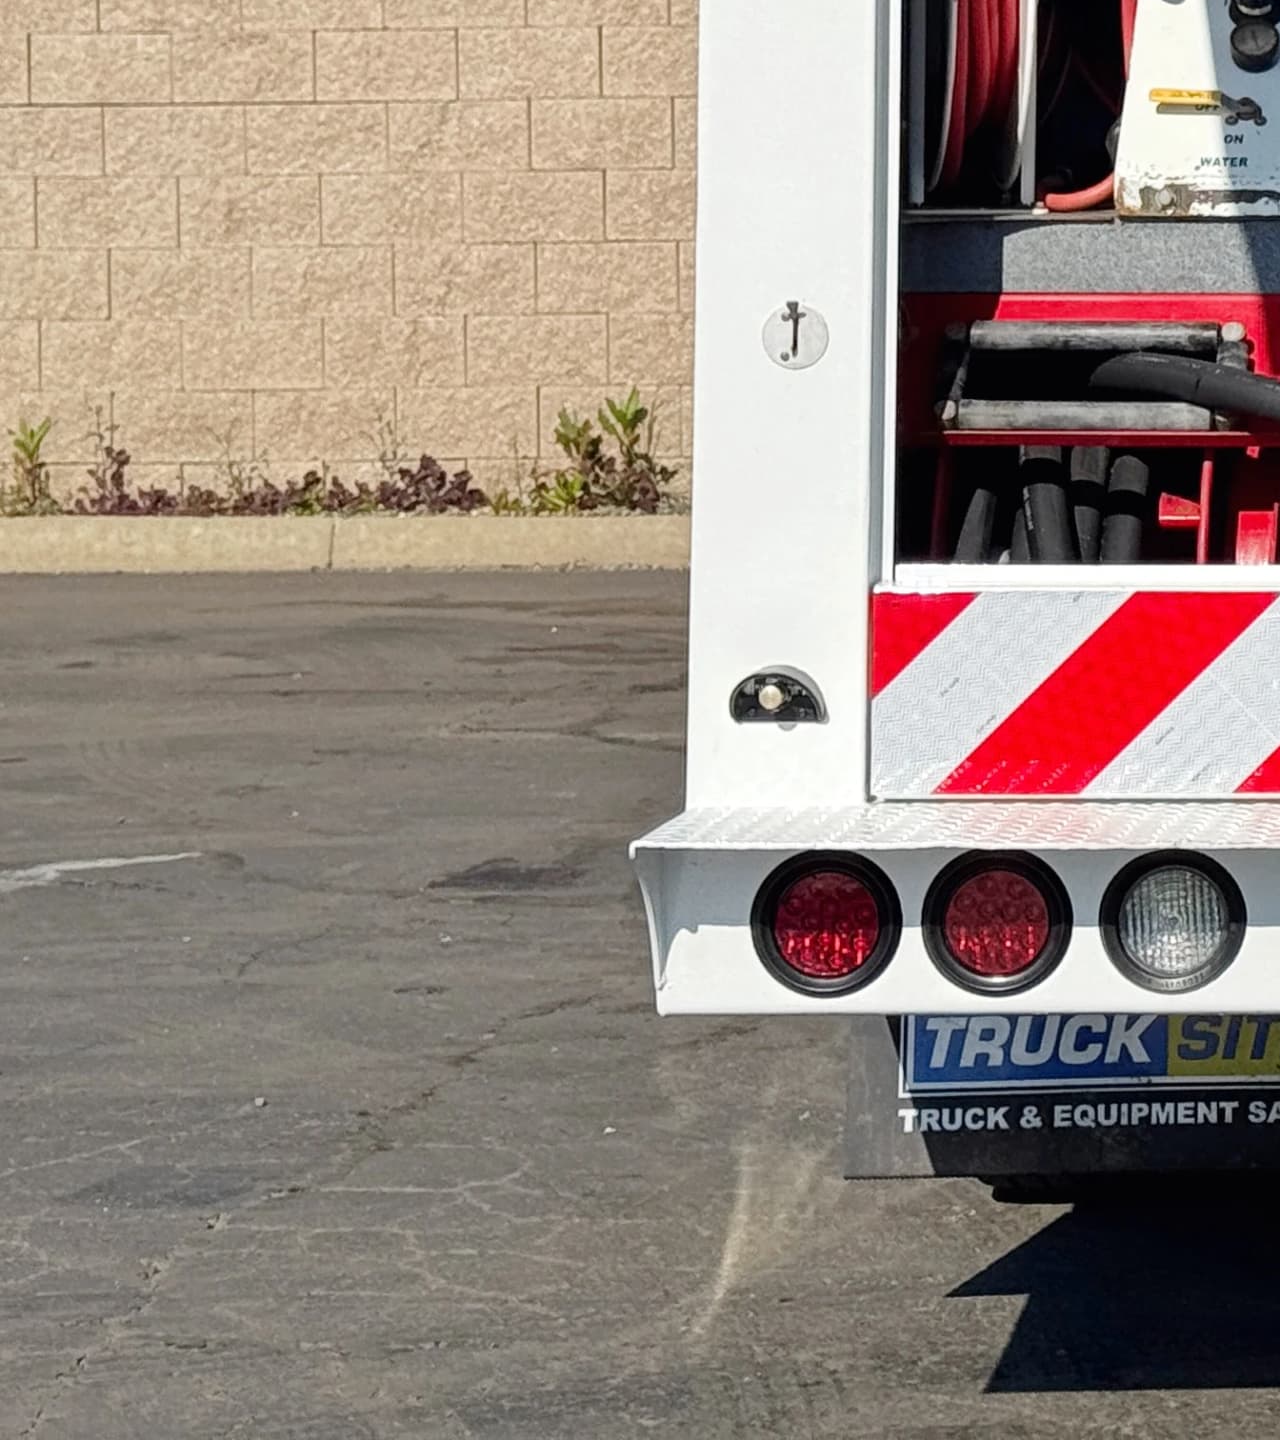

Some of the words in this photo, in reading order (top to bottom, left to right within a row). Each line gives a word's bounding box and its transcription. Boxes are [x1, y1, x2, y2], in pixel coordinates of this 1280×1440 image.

[1224, 134, 1244, 144] ON
[1200, 157, 1248, 167] WATER
[924, 1014, 1155, 1068] TRUCK
[898, 1107, 1009, 1133] TRUCK
[1020, 1106, 1042, 1128] &
[1053, 1100, 1239, 1128] EQUIPMENT
